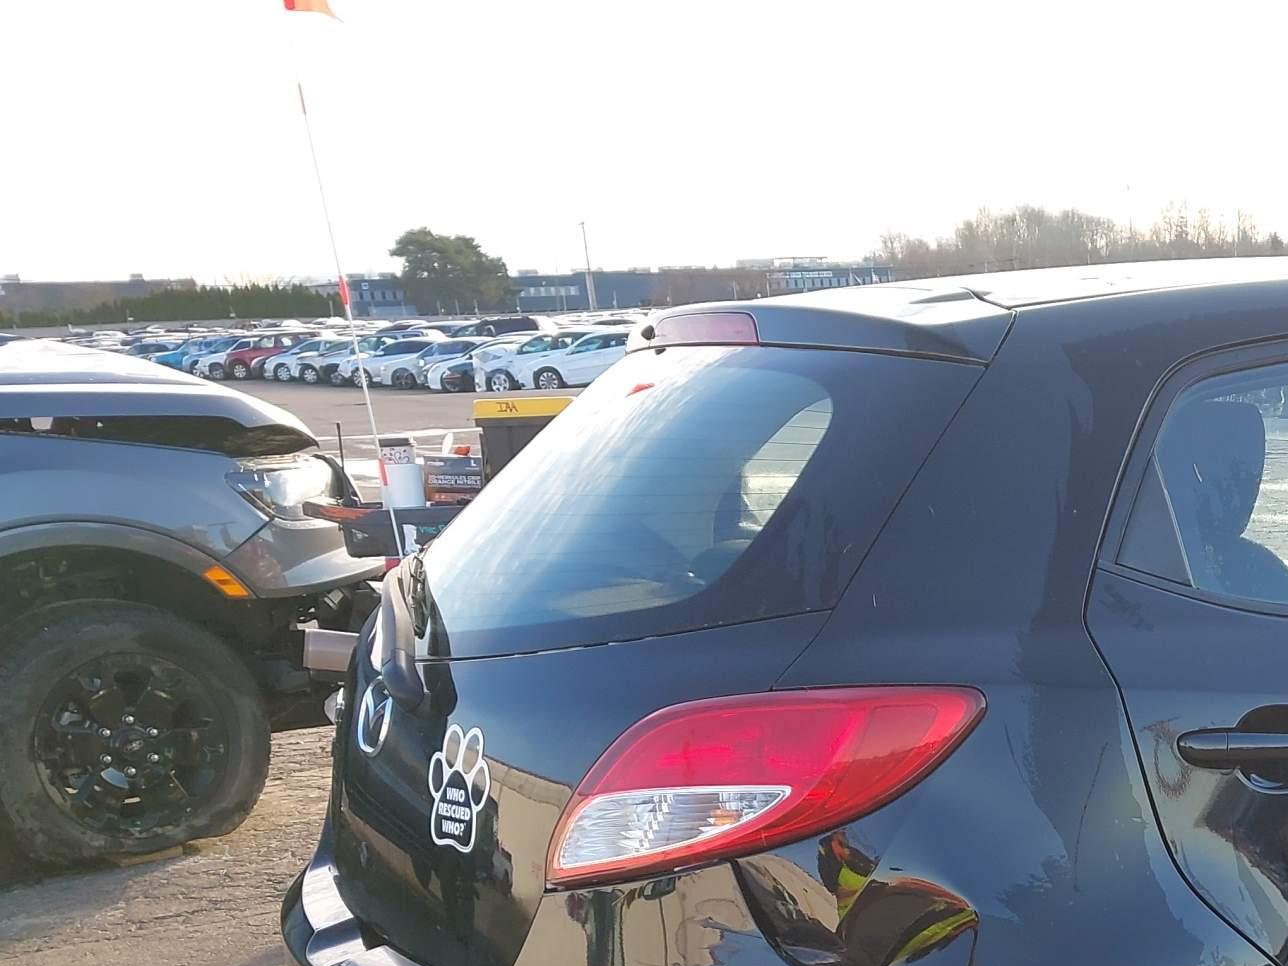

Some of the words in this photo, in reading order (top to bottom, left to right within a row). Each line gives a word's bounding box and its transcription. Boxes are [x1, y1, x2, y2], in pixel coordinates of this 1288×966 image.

[446, 786, 465, 803] WHO
[438, 802, 471, 820] RESCUED
[441, 818, 464, 836] WHO?
